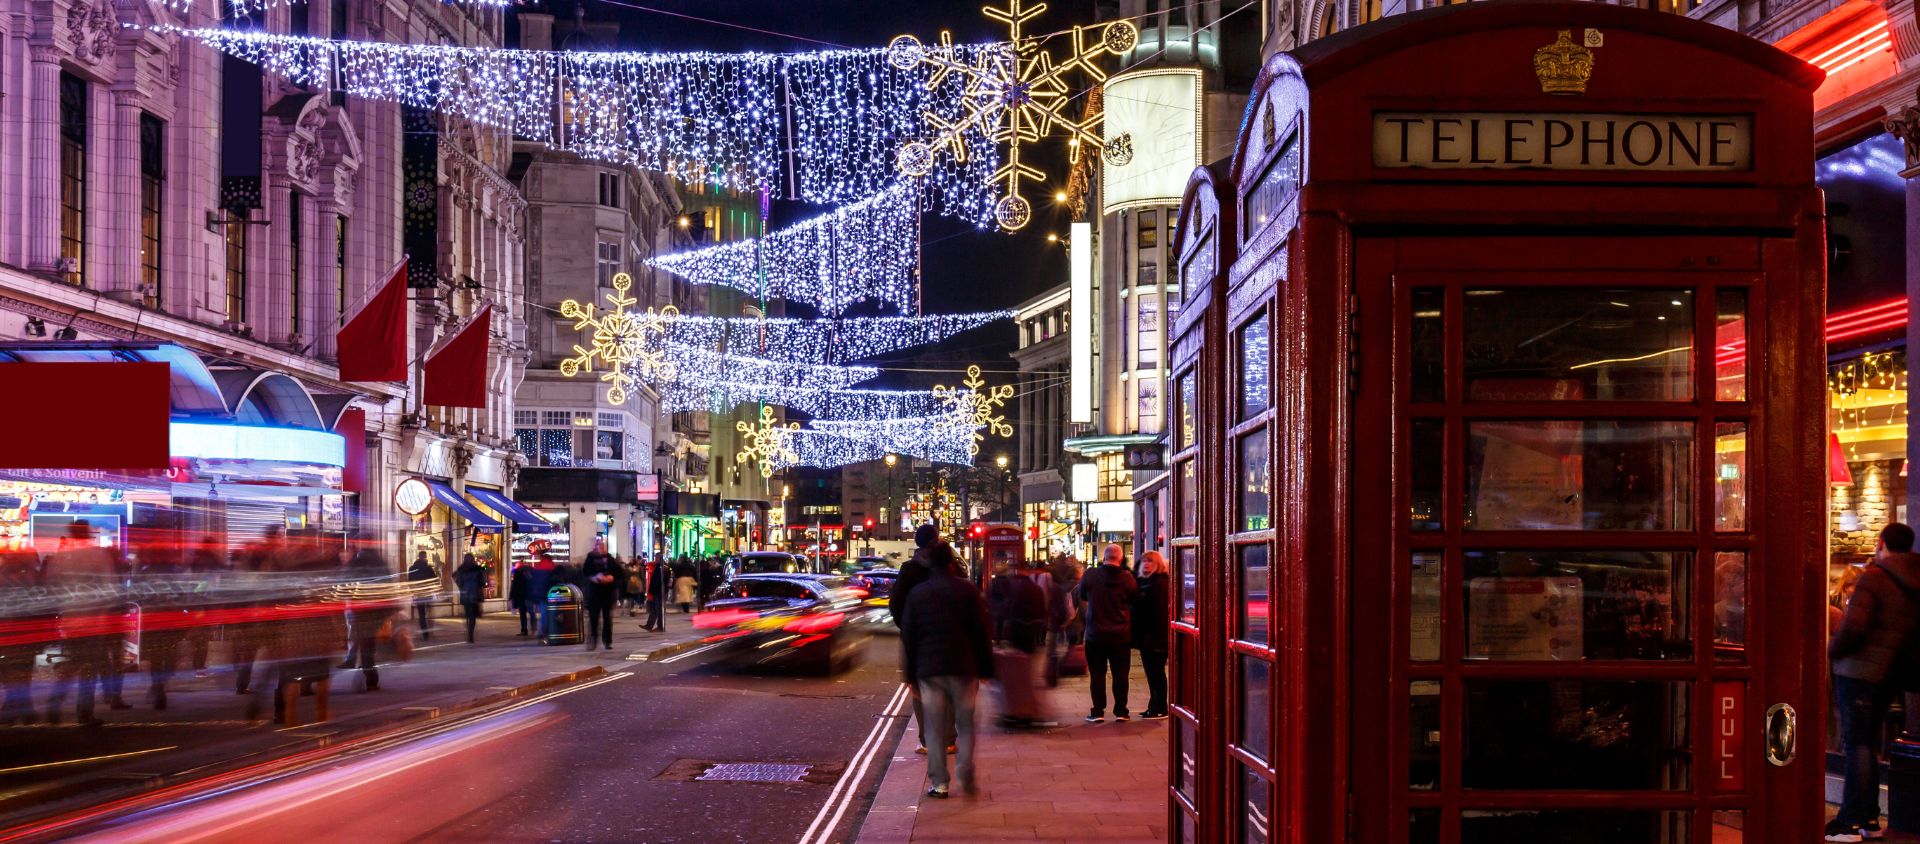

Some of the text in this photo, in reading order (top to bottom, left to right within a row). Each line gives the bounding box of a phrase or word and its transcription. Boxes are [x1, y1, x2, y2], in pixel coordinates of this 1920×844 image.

[1384, 118, 1737, 167] TELEPHONE
[45, 468, 107, 479] Souvenir
[528, 541, 551, 554] SALE
[1721, 696, 1735, 779] PULL
